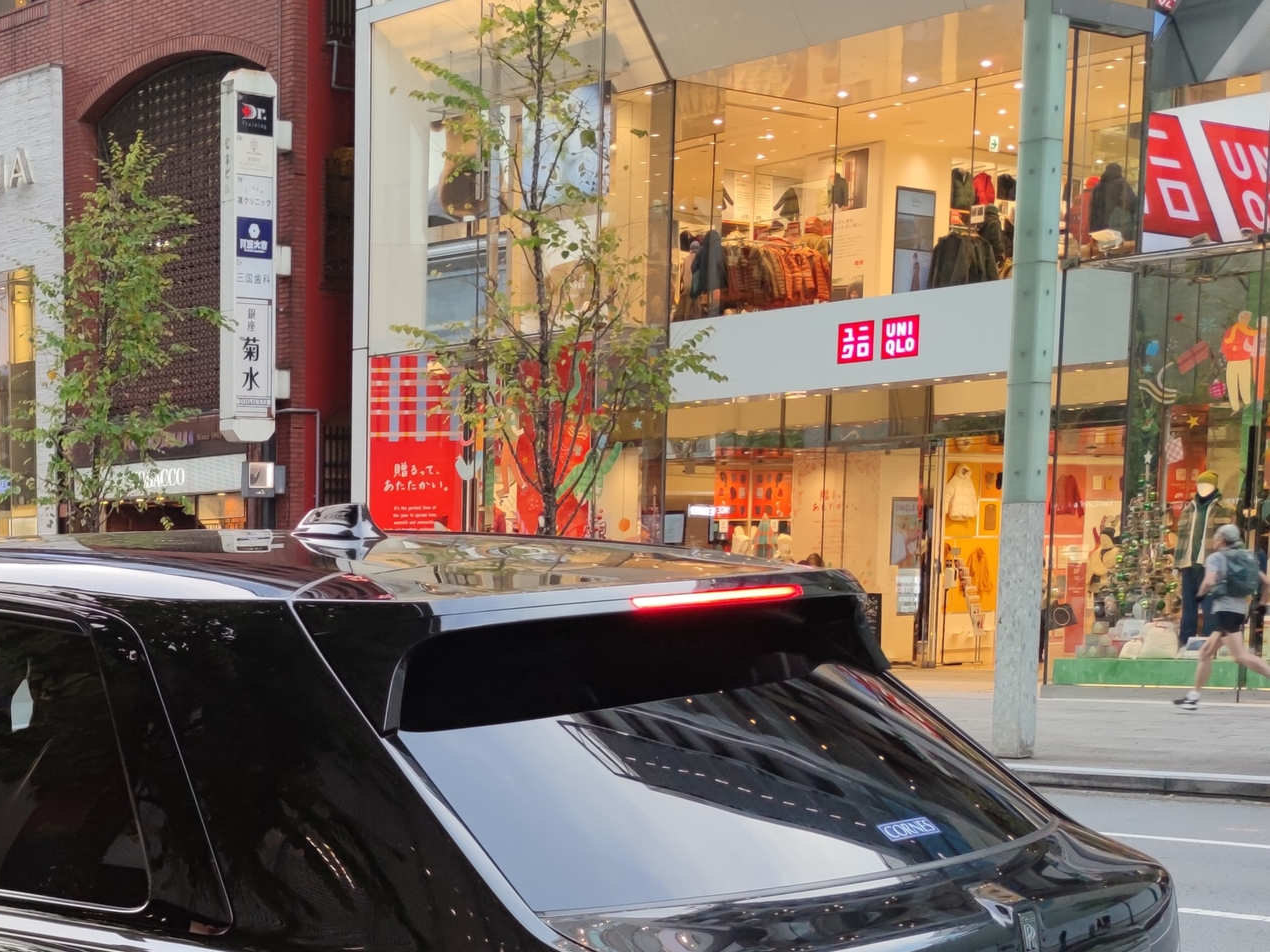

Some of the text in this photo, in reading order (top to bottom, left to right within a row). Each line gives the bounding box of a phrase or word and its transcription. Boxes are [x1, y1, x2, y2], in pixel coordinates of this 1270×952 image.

[242, 102, 267, 120] Dr.
[843, 325, 870, 343] ユニ
[886, 321, 913, 337] UNI
[243, 308, 260, 391] 銀座 菊水
[841, 342, 869, 359] クロ
[885, 337, 915, 356] QLO
[383, 479, 449, 492] あたたかい。
[884, 820, 936, 838] CORNES
